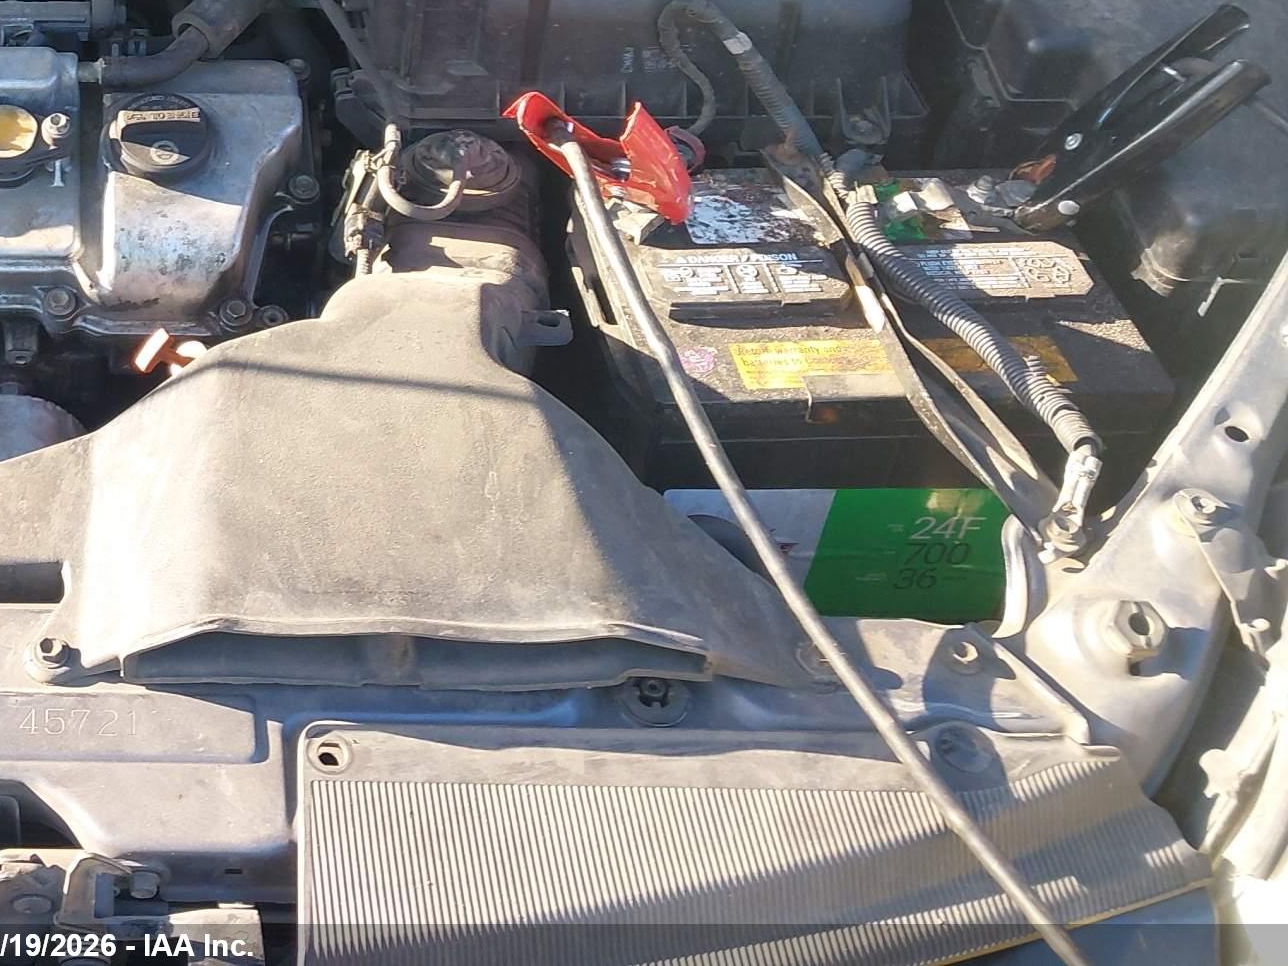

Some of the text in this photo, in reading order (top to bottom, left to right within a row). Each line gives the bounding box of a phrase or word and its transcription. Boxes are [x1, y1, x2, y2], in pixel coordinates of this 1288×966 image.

[909, 516, 987, 540] 24F
[904, 542, 971, 564] 700
[893, 567, 937, 590] 36
[19, 708, 137, 736] 45721
